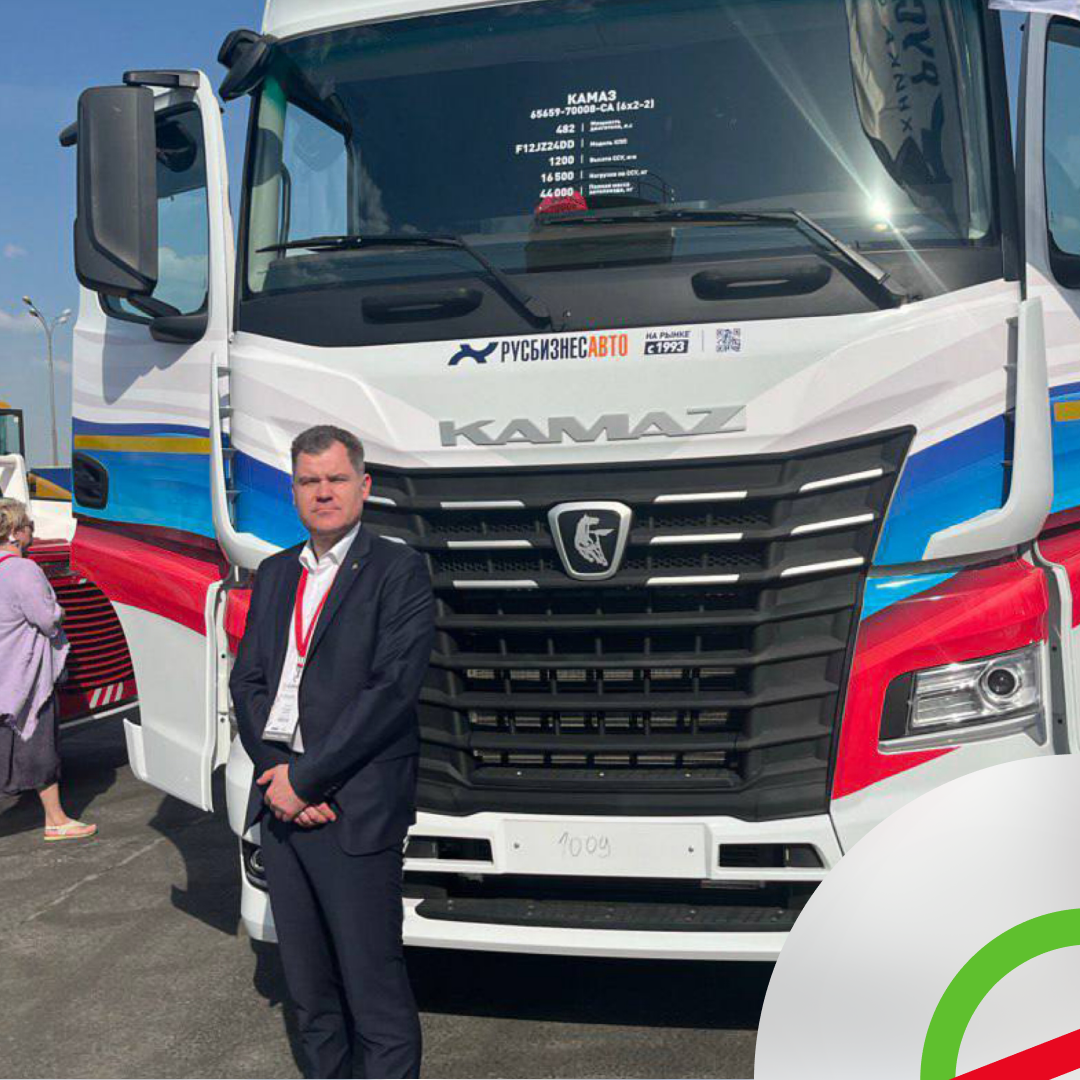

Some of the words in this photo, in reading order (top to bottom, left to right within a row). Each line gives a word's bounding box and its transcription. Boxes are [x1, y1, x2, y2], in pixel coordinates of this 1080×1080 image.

[567, 90, 617, 105] КАМАЗ
[556, 123, 575, 134] 482
[549, 155, 575, 166] 1200
[500, 333, 628, 363] РУСБИЗНЕСАВТО
[438, 405, 747, 447] KAMAZ
